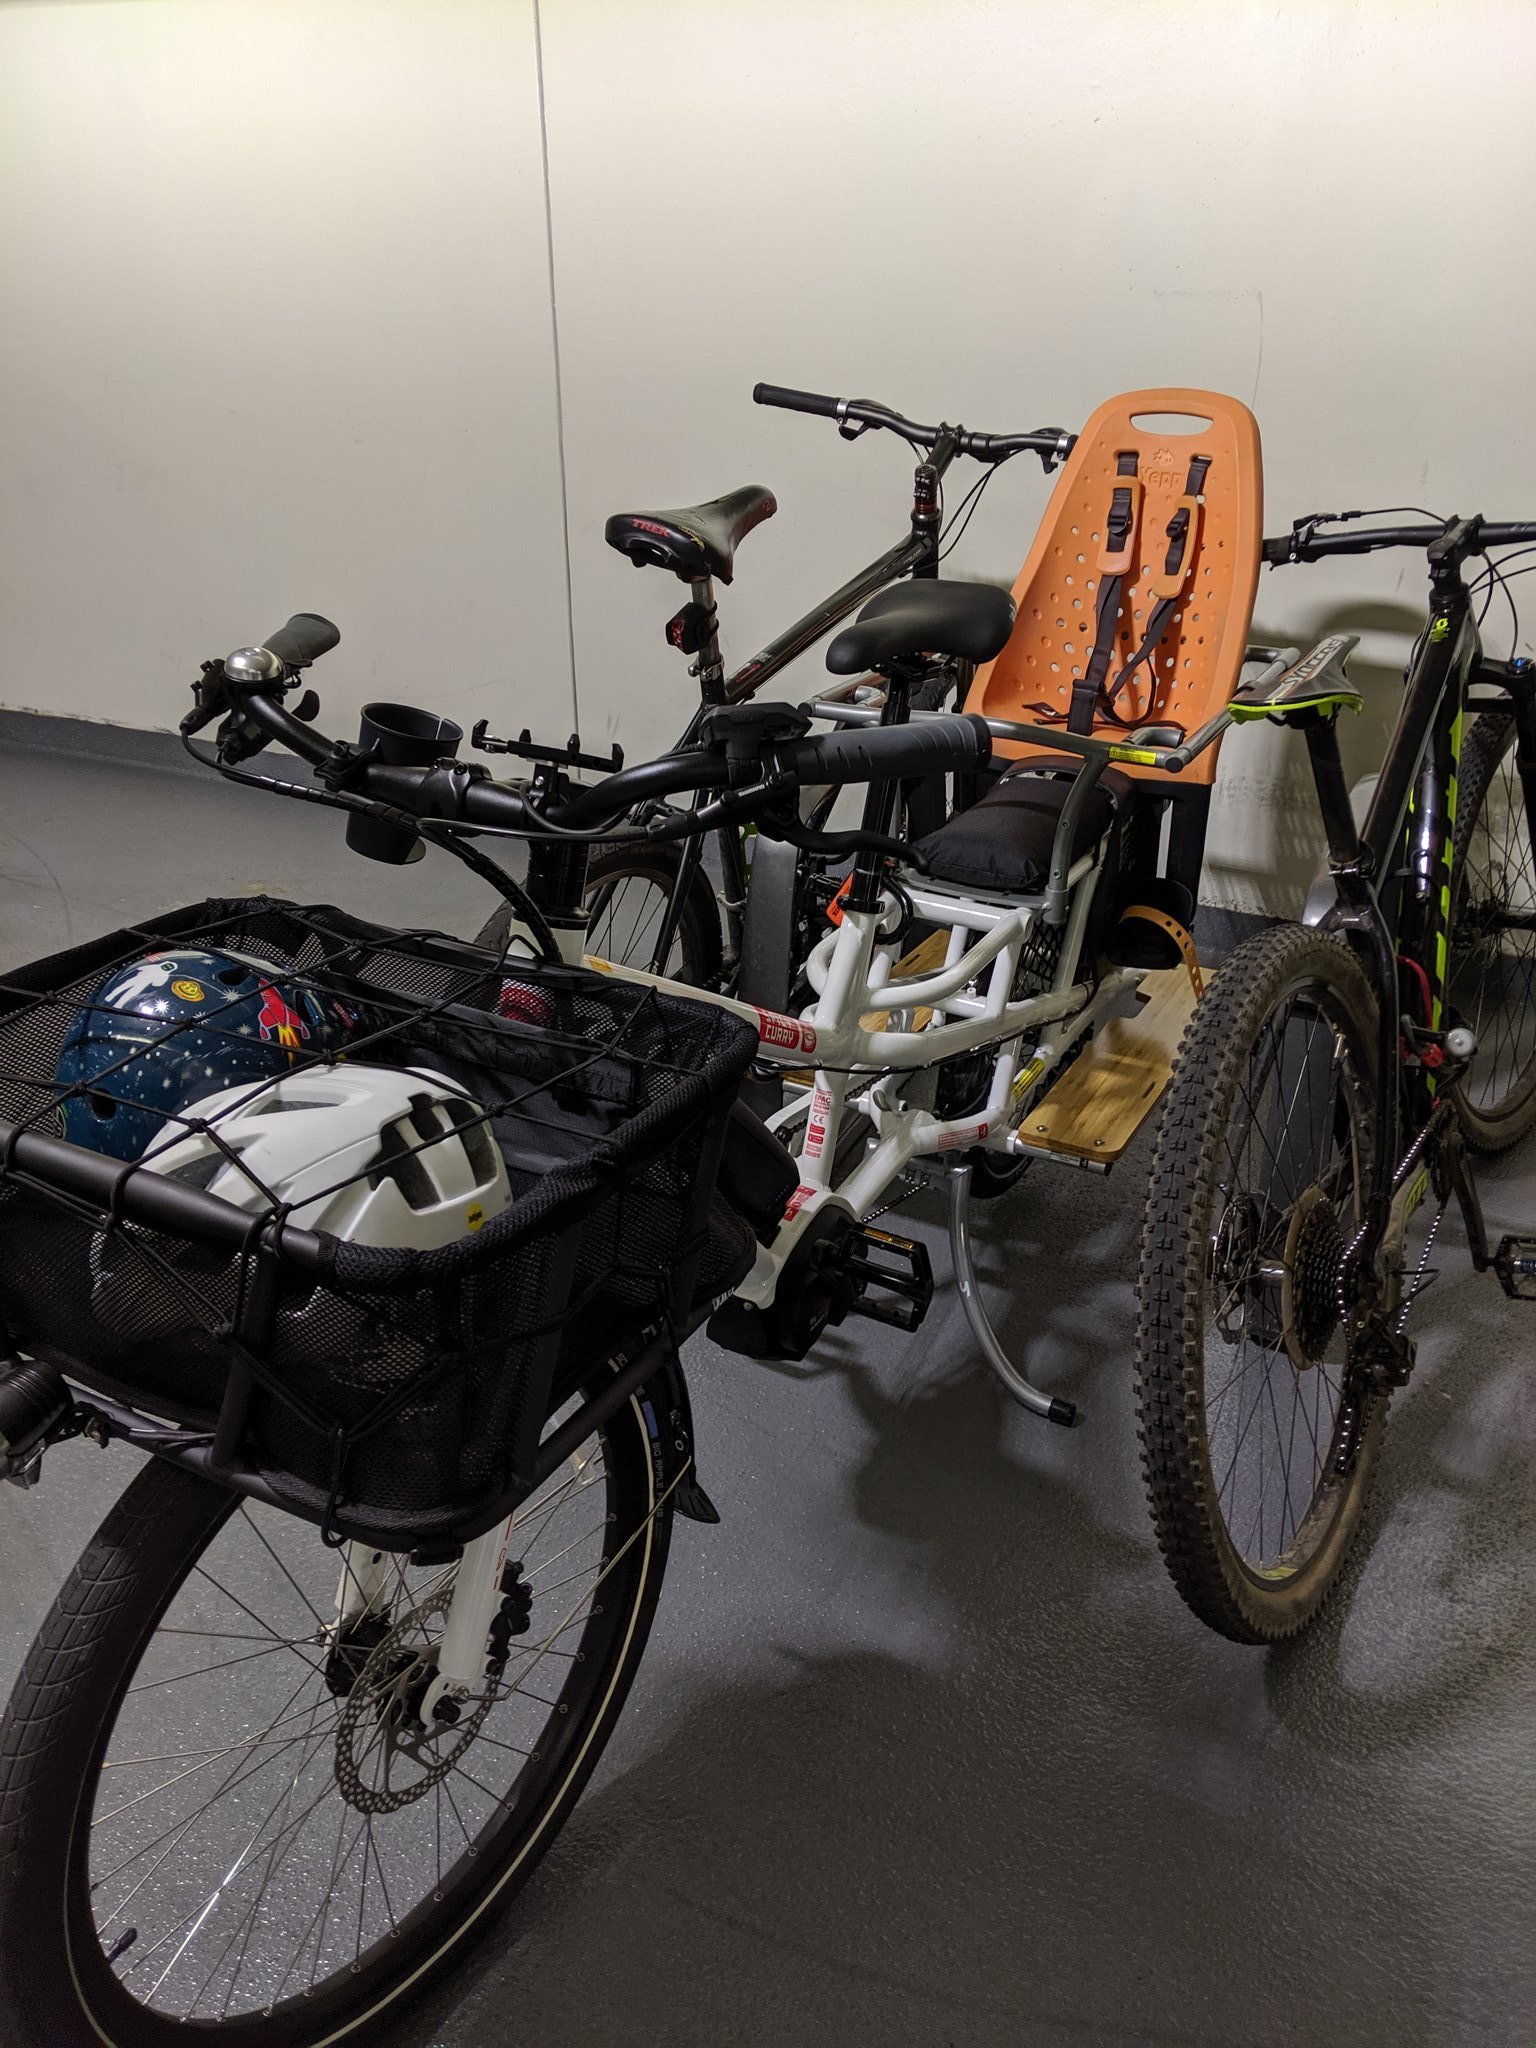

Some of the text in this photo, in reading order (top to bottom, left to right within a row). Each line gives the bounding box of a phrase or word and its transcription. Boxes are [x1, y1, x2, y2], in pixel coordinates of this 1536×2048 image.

[1140, 467, 1185, 489] Yepp
[632, 518, 670, 537] TREK
[765, 1024, 794, 1045] CURRY
[815, 1093, 831, 1104] EPAC
[652, 1441, 662, 1457] BIG
[655, 1459, 664, 1489] APPLE
